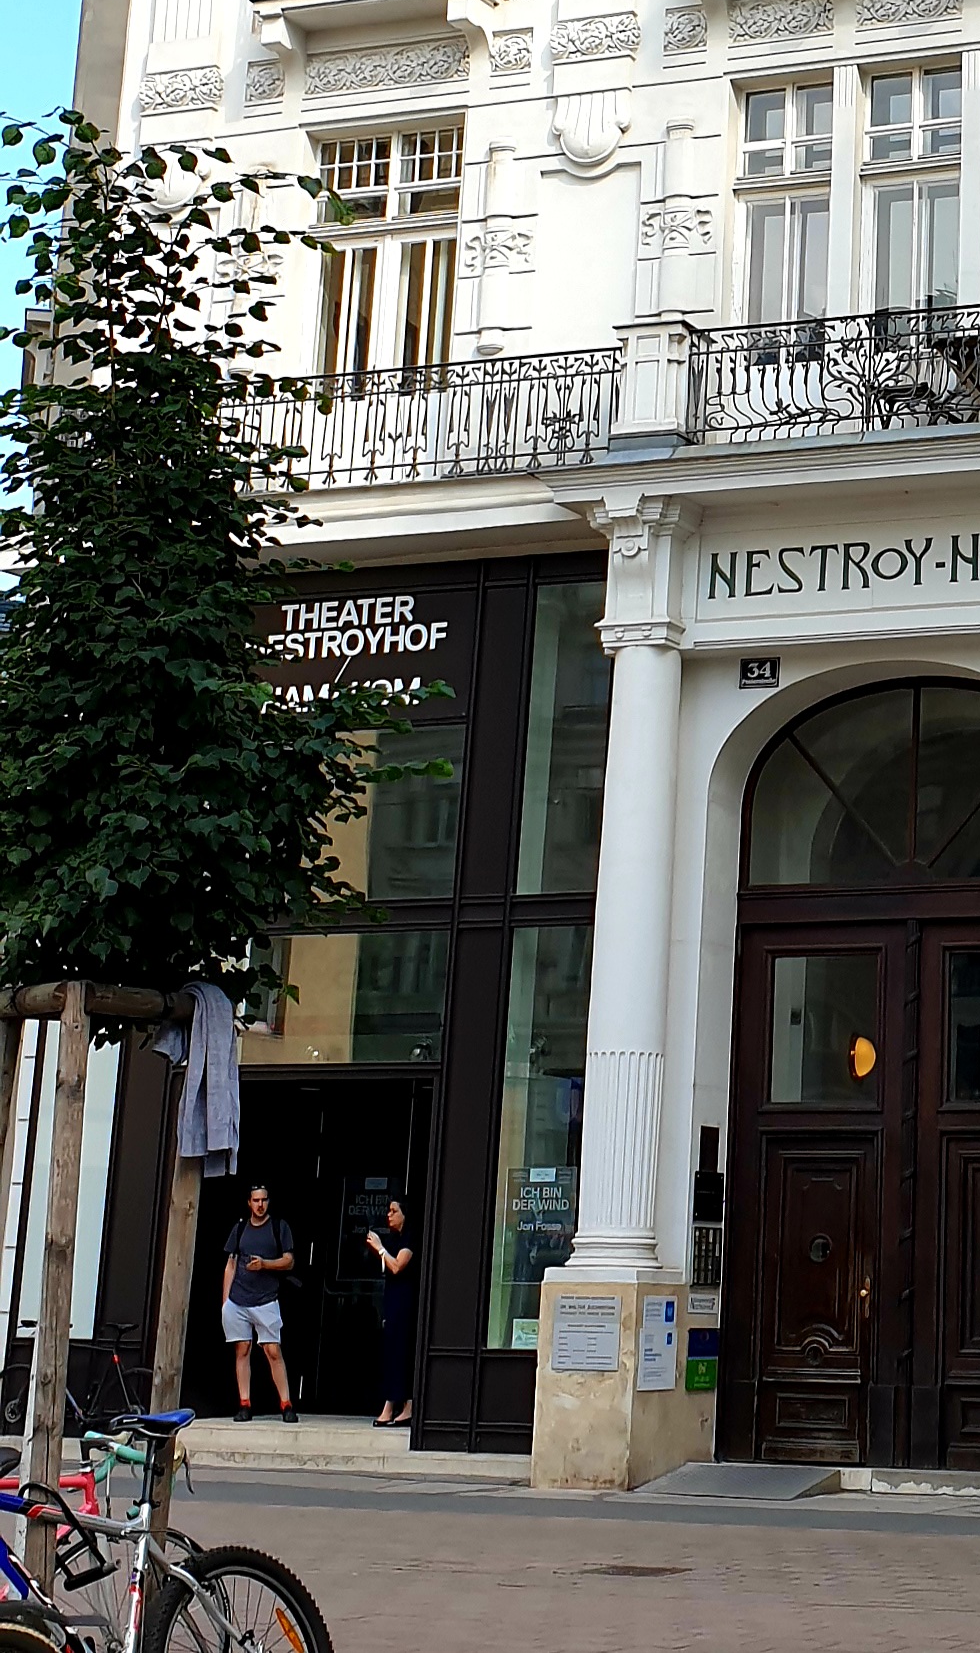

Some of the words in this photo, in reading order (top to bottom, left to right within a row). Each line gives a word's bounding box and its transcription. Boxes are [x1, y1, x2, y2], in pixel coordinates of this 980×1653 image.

[281, 595, 416, 632] THEATER
[245, 621, 448, 661] ESTROYHOF
[747, 661, 771, 678] 34
[520, 1186, 540, 1199] ICH
[542, 1186, 562, 1199] BIN
[512, 1198, 536, 1211] DER
[537, 1198, 570, 1211] WIND
